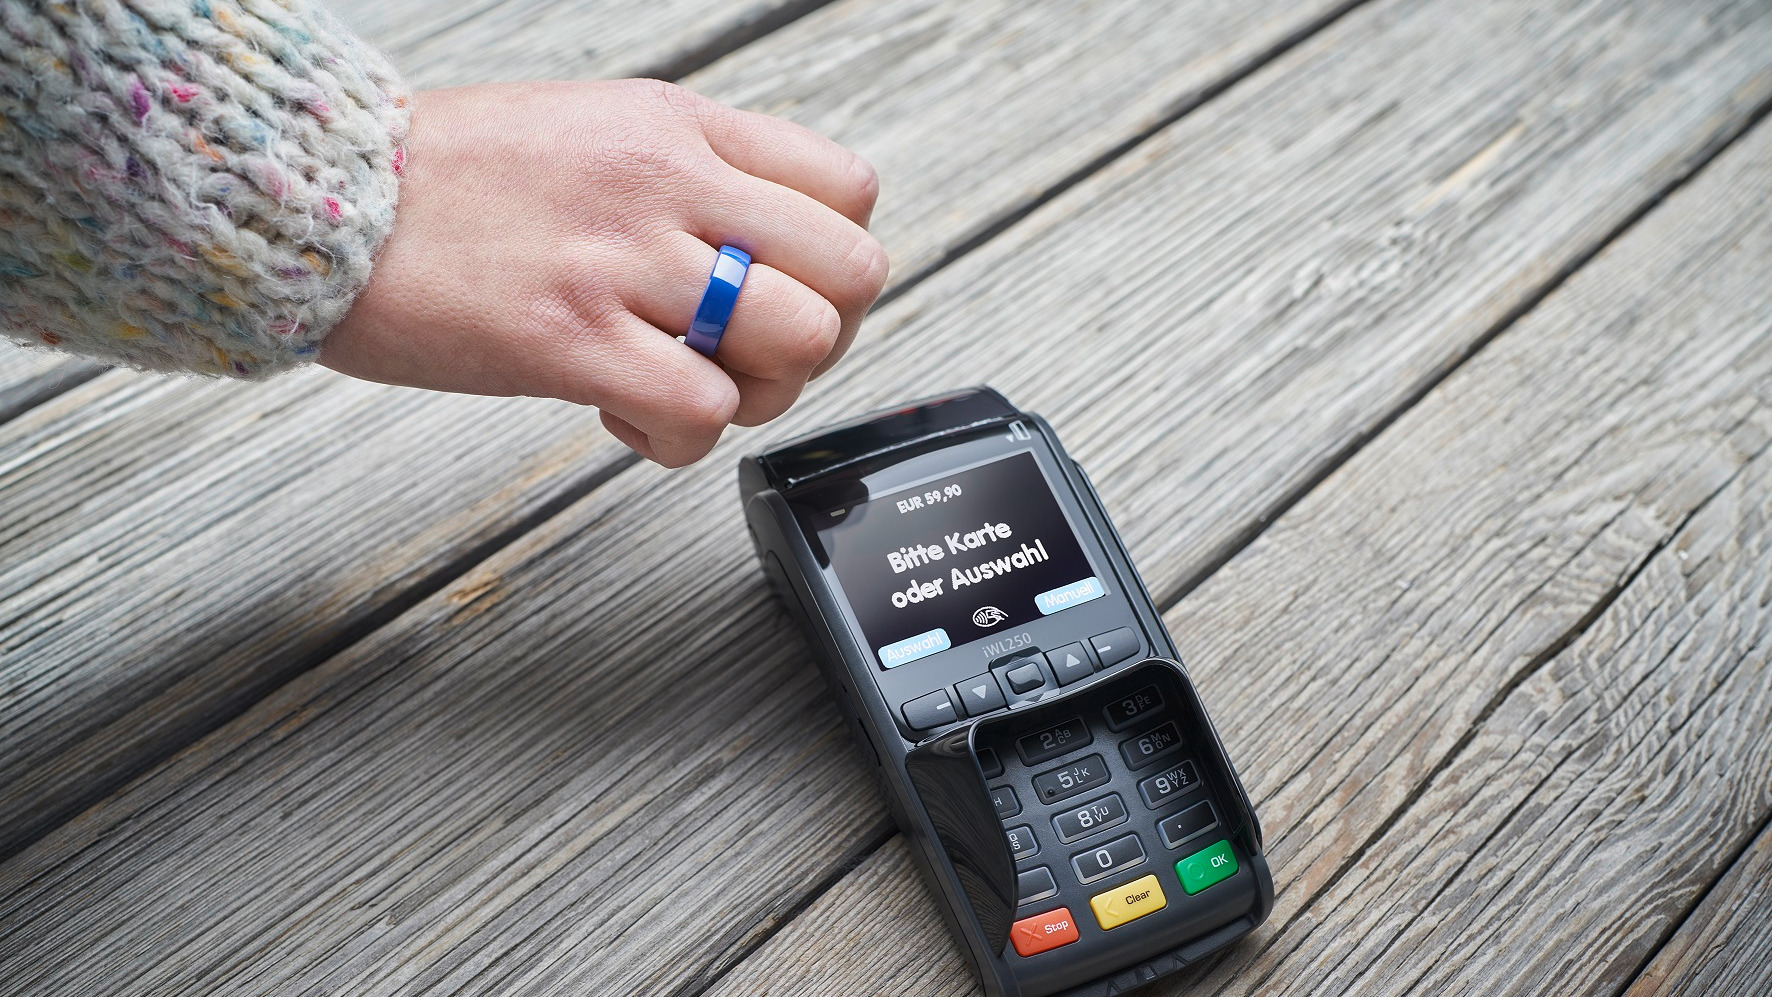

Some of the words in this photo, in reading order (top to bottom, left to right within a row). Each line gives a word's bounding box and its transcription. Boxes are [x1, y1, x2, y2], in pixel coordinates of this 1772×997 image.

[896, 495, 925, 514] EUR
[926, 483, 962, 503] 59,90
[887, 543, 945, 574] Bitte
[944, 522, 1013, 555] Karte
[891, 577, 944, 609] oder
[950, 538, 1050, 590] Auswahl
[1044, 581, 1095, 609] Manuell
[886, 632, 943, 663] Auswahl
[983, 632, 1033, 658] iWL250
[1122, 699, 1138, 716] 3
[1039, 732, 1057, 750] 2
[1138, 738, 1154, 755] 6
[1057, 771, 1075, 789] 5
[1155, 776, 1172, 795] 9
[1077, 809, 1094, 828] 8
[1095, 849, 1113, 868] 0
[1210, 853, 1229, 868] OK
[1125, 889, 1151, 905] Clear
[1044, 919, 1069, 935] Stop
